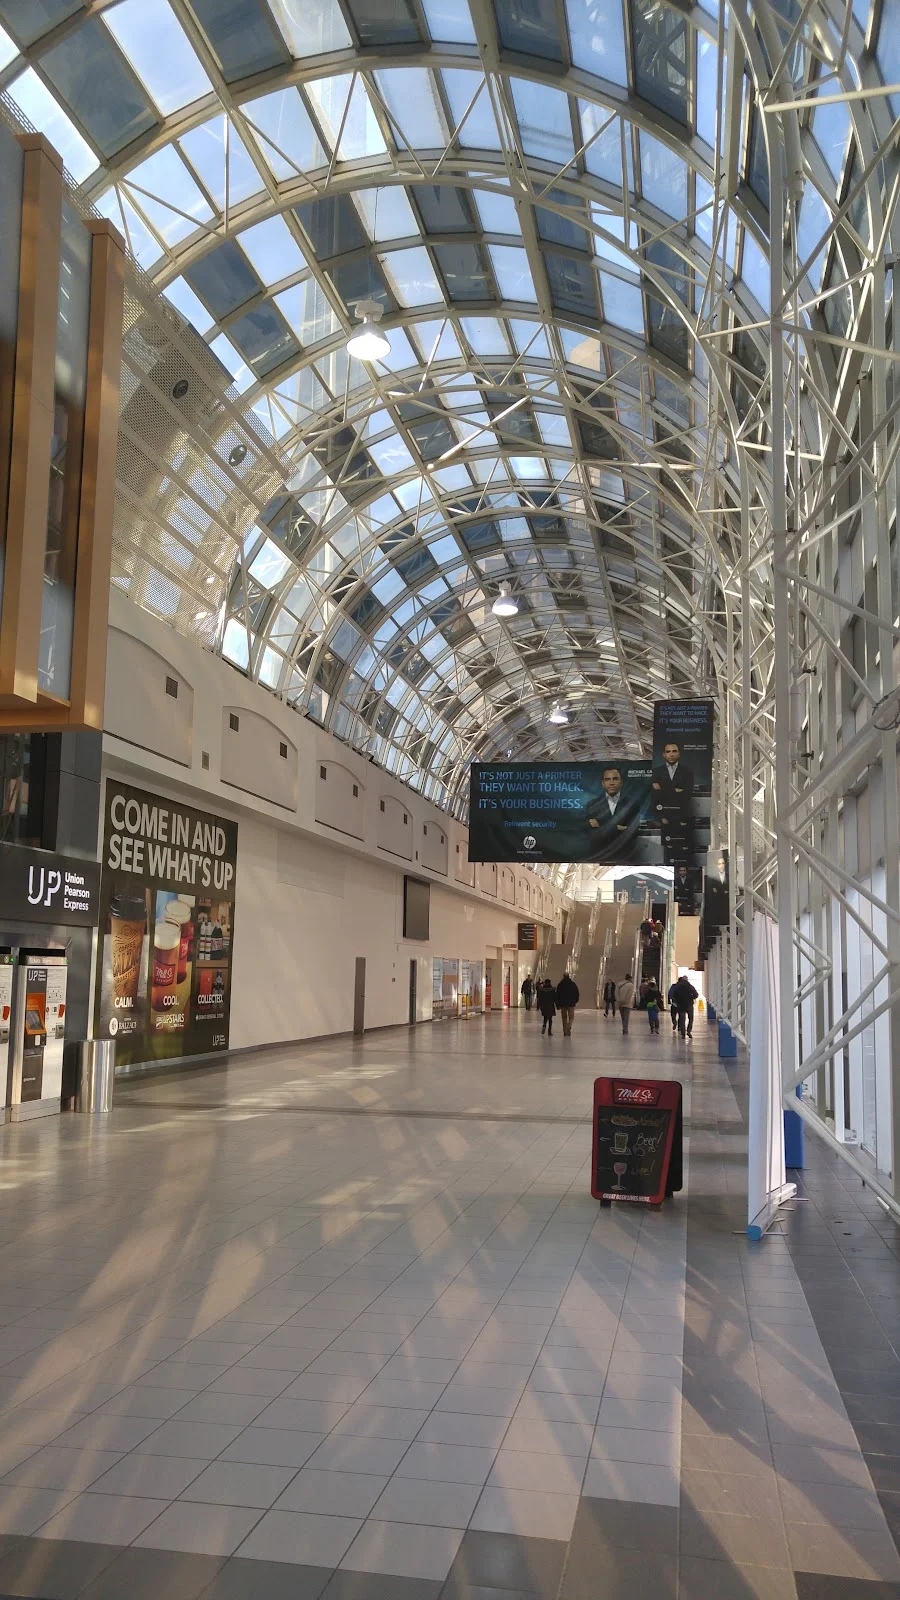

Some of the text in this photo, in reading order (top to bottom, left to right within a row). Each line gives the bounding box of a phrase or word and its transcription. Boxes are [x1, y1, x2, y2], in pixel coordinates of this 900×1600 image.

[479, 771, 582, 780] IT'S NOT JUST A PRINTER
[479, 782, 584, 792] THEY WANT TO HACK.
[479, 798, 584, 809] IT'S YOUR BUSINESS.
[110, 795, 226, 857] COME IN AND
[504, 820, 557, 829] Reinvent security
[108, 834, 233, 890] SEE WHAT'S UP
[65, 872, 84, 885] Union
[27, 866, 61, 906] UP
[64, 885, 90, 898] Pearson
[63, 898, 89, 911] Express
[114, 996, 134, 1008] CALM.
[163, 995, 180, 1006] COOL.
[197, 994, 223, 1004] COLLECTED.
[617, 1088, 641, 1098] Mill
[636, 1131, 664, 1146] Beer!
